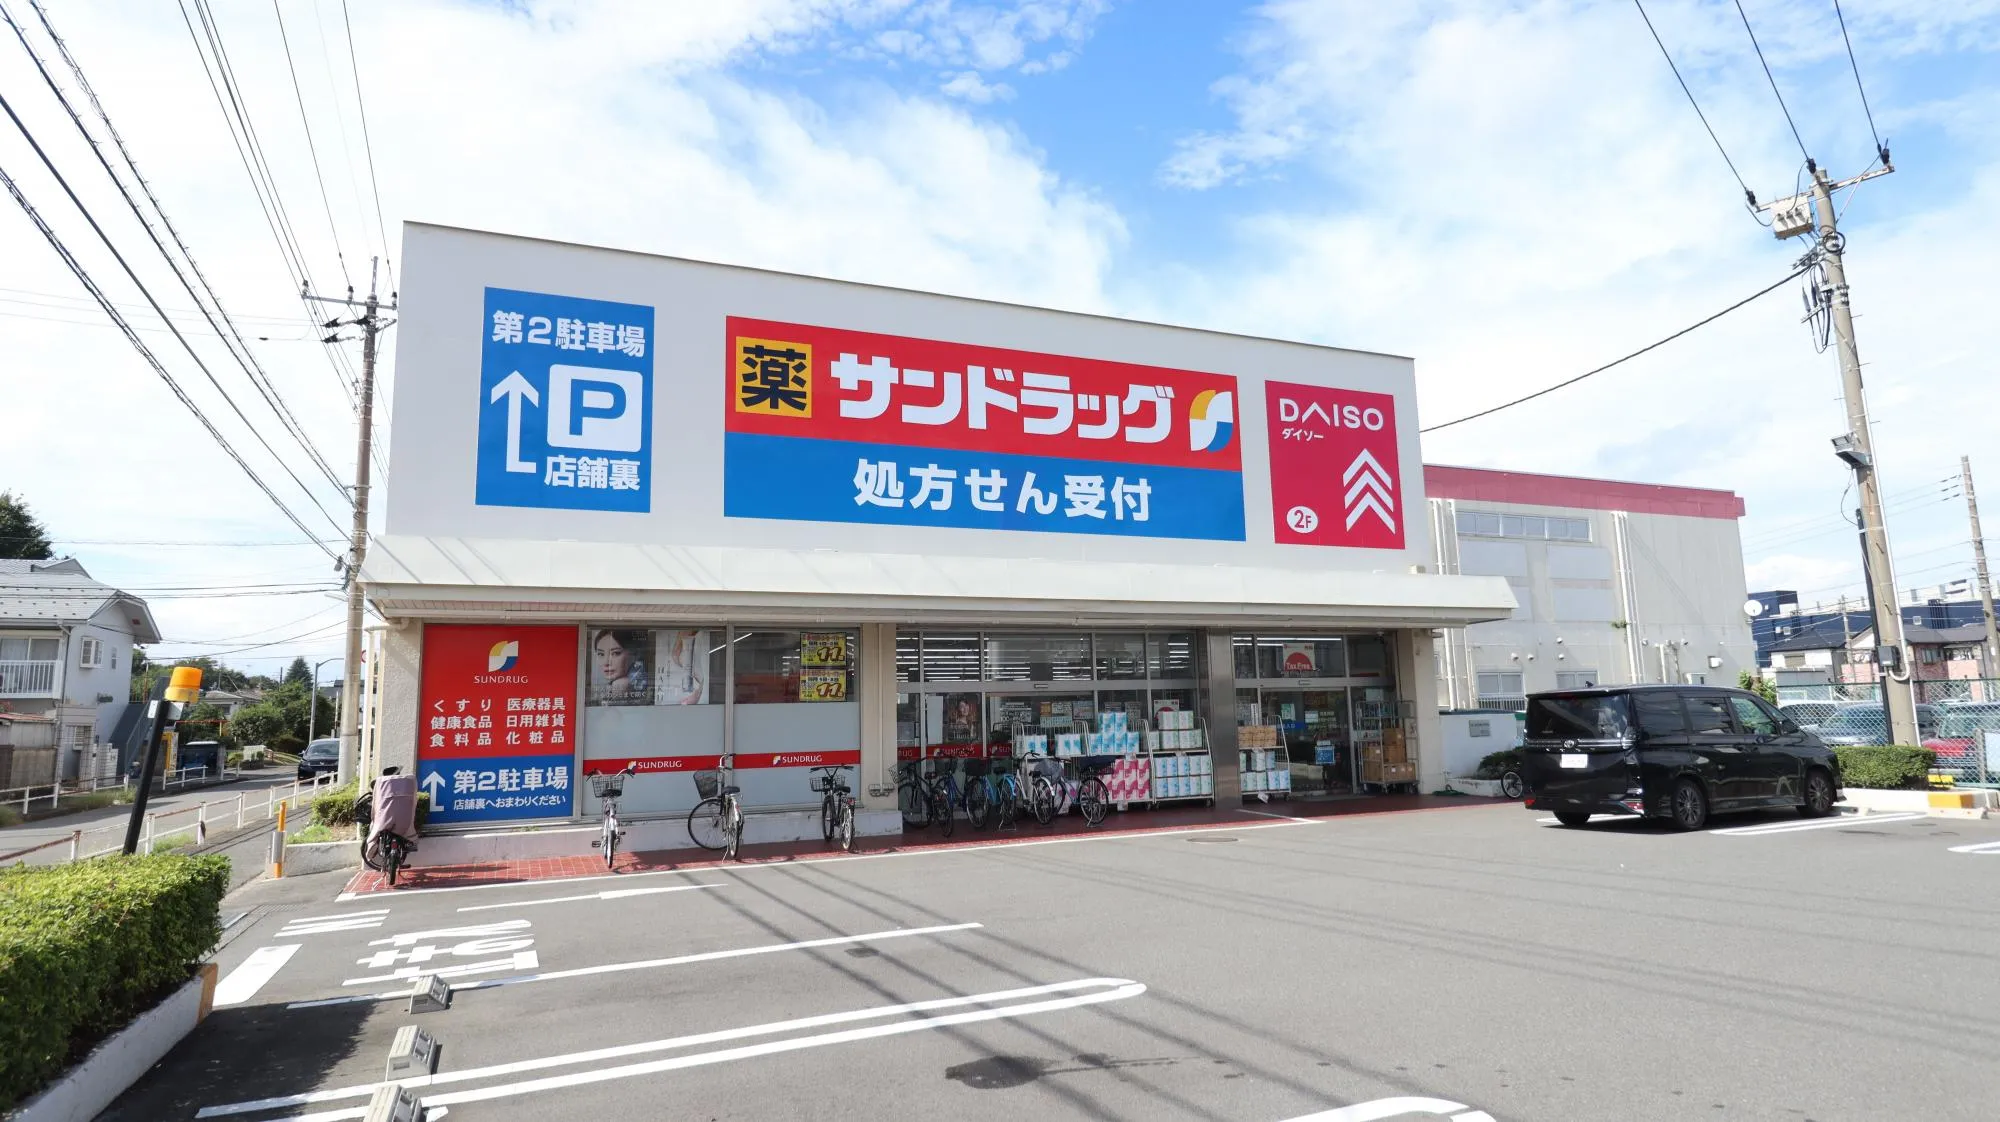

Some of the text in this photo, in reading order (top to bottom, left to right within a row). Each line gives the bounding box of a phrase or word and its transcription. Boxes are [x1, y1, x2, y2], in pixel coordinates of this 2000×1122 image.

[492, 310, 646, 358] 第2駐車場
[741, 345, 807, 412] 薬
[569, 378, 627, 436] P
[830, 352, 1176, 444] サンドラッグ
[1279, 398, 1384, 431] DAISO
[1282, 427, 1325, 442] ダイソー
[544, 455, 641, 491] 店舗裏
[852, 457, 1152, 522] 処方せん受付
[1294, 509, 1312, 529] 2F
[473, 675, 529, 684] SUNDRUG
[434, 697, 566, 713] くすり 医療器具
[430, 714, 566, 730] 健康食品 日用雑貨
[430, 730, 565, 748] 食料品 化粧品
[637, 760, 682, 770] SUNDRUG
[782, 754, 823, 764] SUNDRUG
[453, 766, 568, 794] 第2駐車場
[453, 795, 566, 811] 店舗裏へおまわりください
